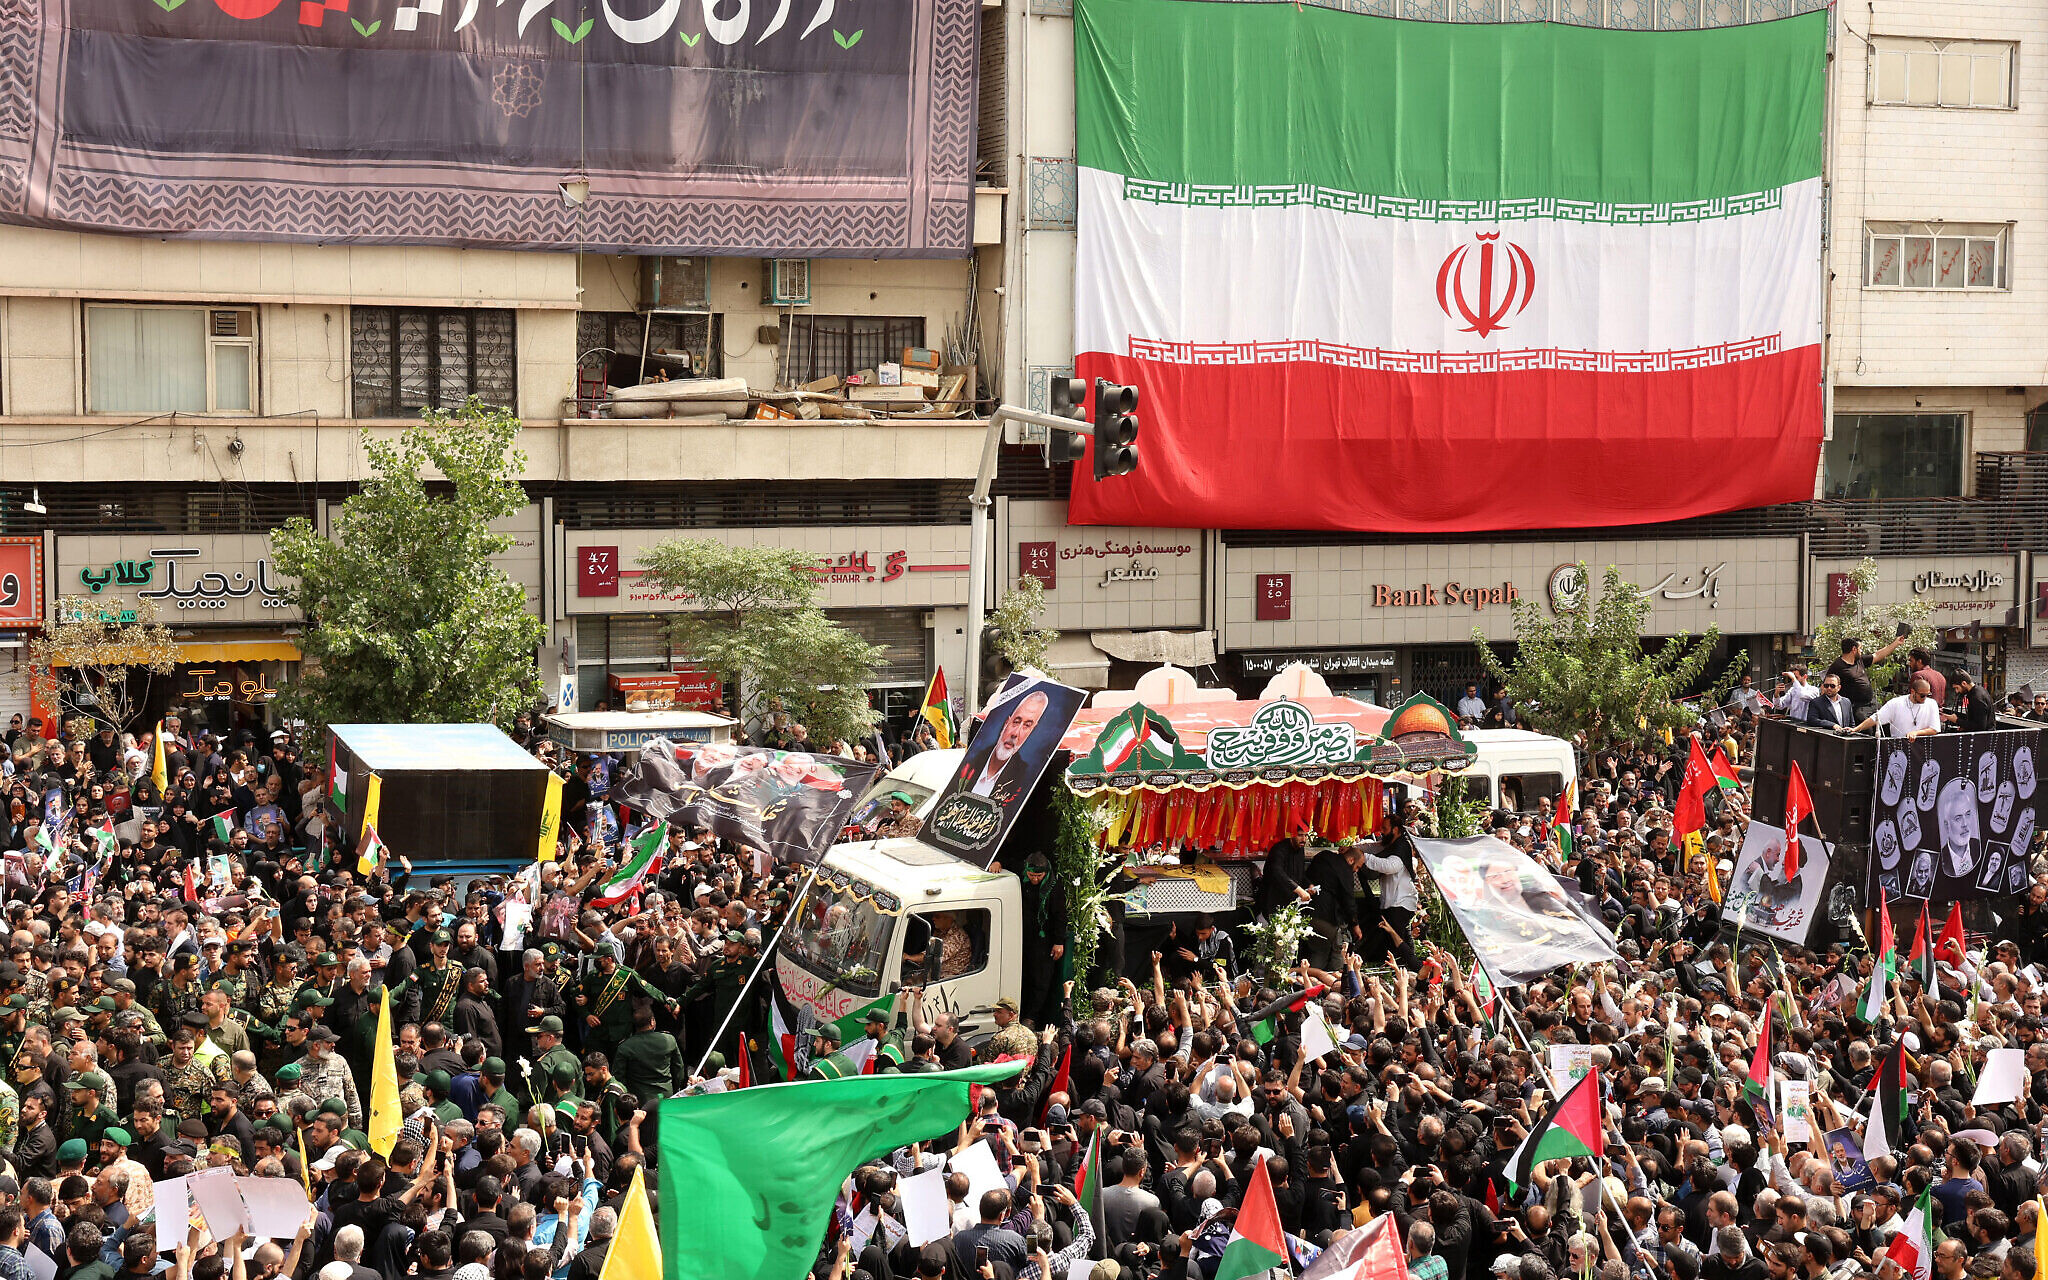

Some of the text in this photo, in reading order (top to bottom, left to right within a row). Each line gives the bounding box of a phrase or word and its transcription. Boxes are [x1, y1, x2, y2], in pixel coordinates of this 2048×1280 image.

[588, 552, 609, 563] 47
[1030, 548, 1049, 557] 46
[81, 560, 155, 593] کلاب
[831, 575, 861, 584] SHAHR
[1099, 560, 1160, 588] مشعر
[1267, 578, 1284, 588] 45
[1373, 582, 1520, 611] Bank Sepah
[609, 732, 654, 747] POLIC
